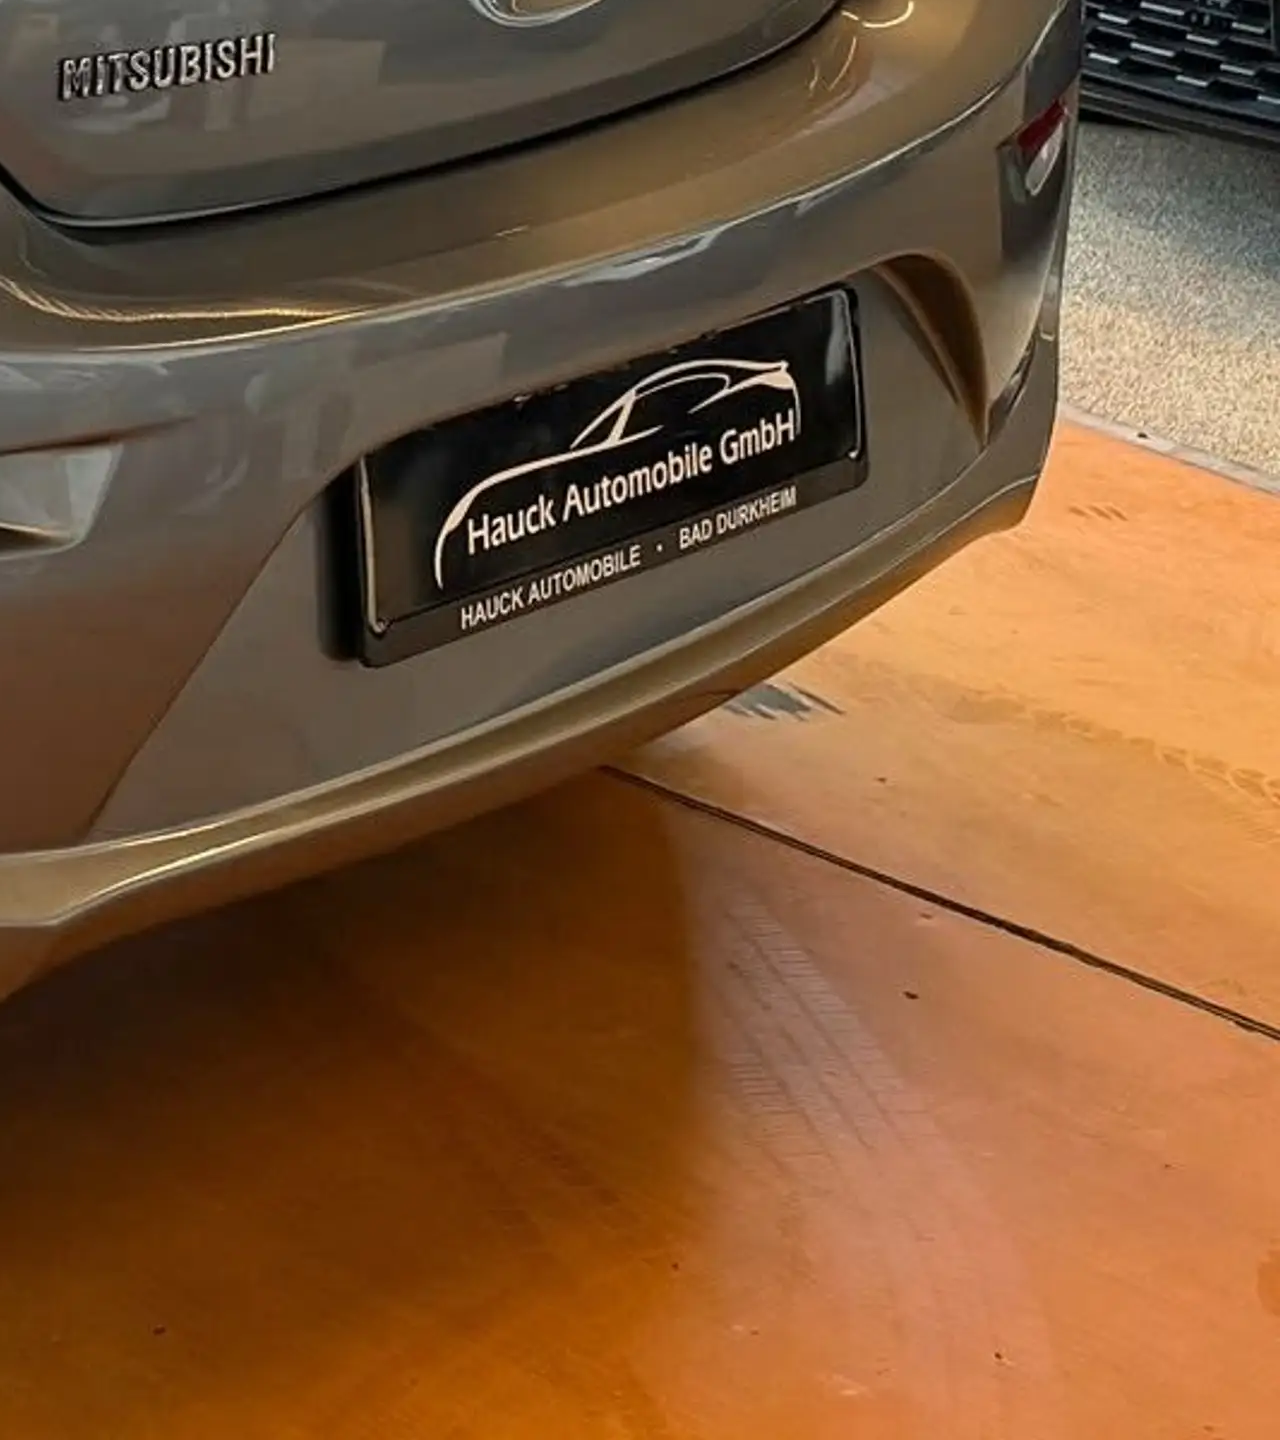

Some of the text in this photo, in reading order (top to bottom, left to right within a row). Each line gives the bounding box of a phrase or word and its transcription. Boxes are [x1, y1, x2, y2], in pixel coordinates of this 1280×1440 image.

[57, 32, 277, 102] MITSUBISHI
[467, 407, 796, 556] Hauck Automobile GmbH
[461, 586, 524, 630] HAUCK
[527, 544, 642, 605] AUTOMOBILE
[679, 517, 713, 550] BAD
